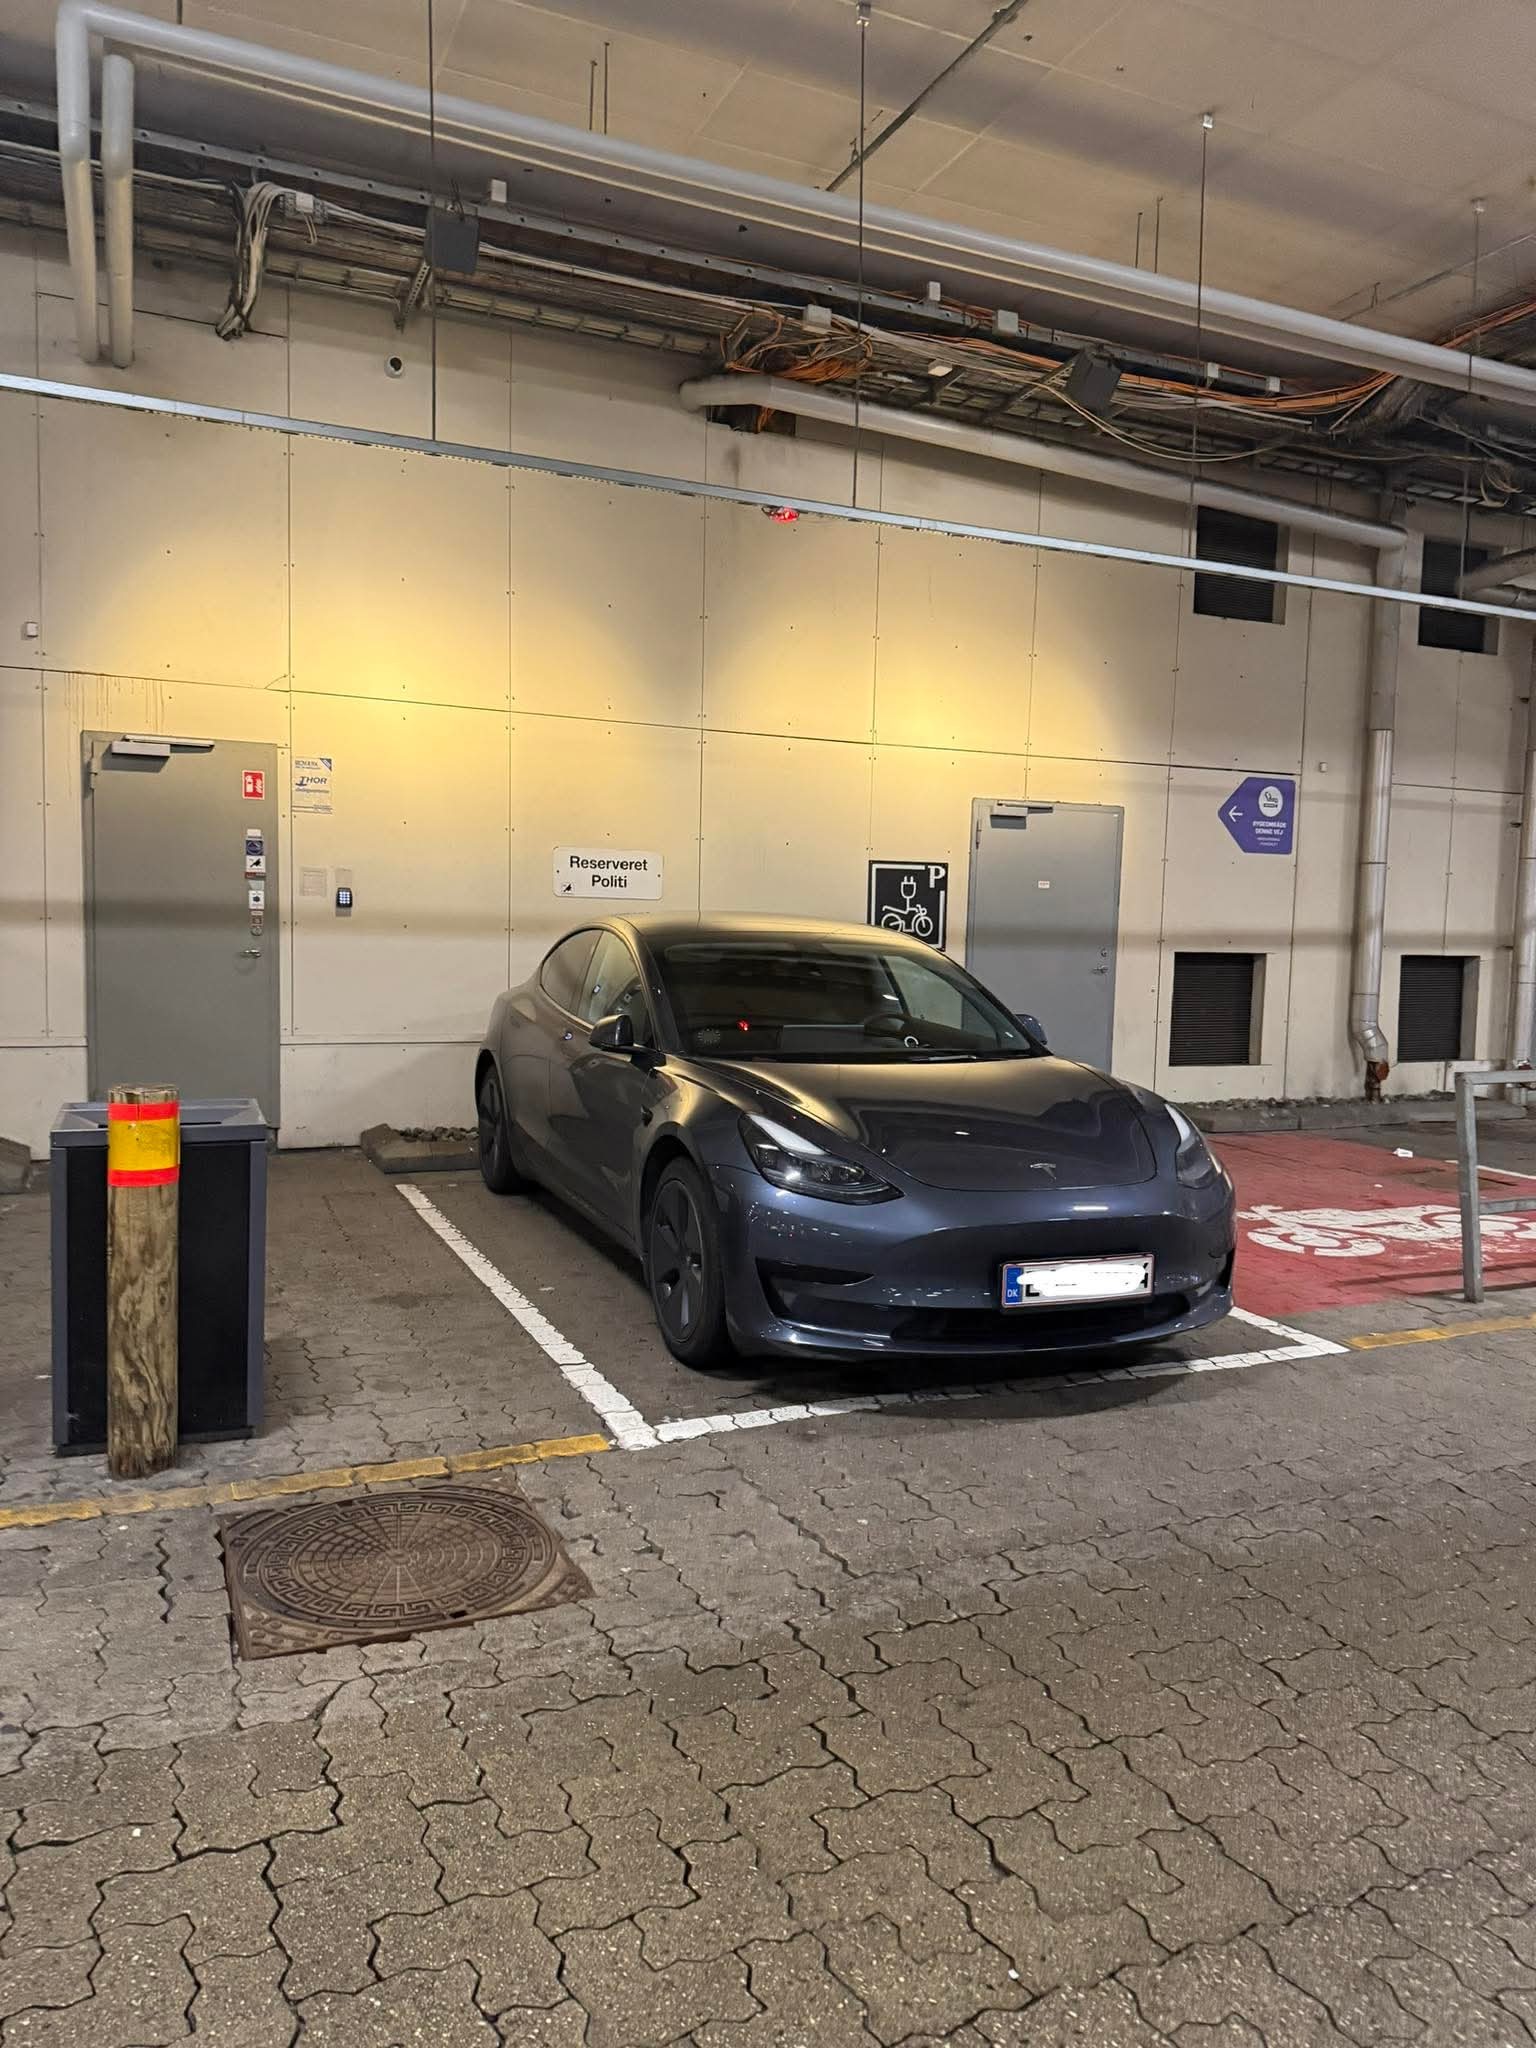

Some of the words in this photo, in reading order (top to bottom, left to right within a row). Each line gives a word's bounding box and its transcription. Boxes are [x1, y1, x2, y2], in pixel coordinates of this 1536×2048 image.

[295, 776, 328, 786] THOR
[569, 855, 648, 871] Reserveret
[591, 874, 628, 888] Politi
[927, 865, 946, 888] P
[1007, 1289, 1018, 1298] DK
